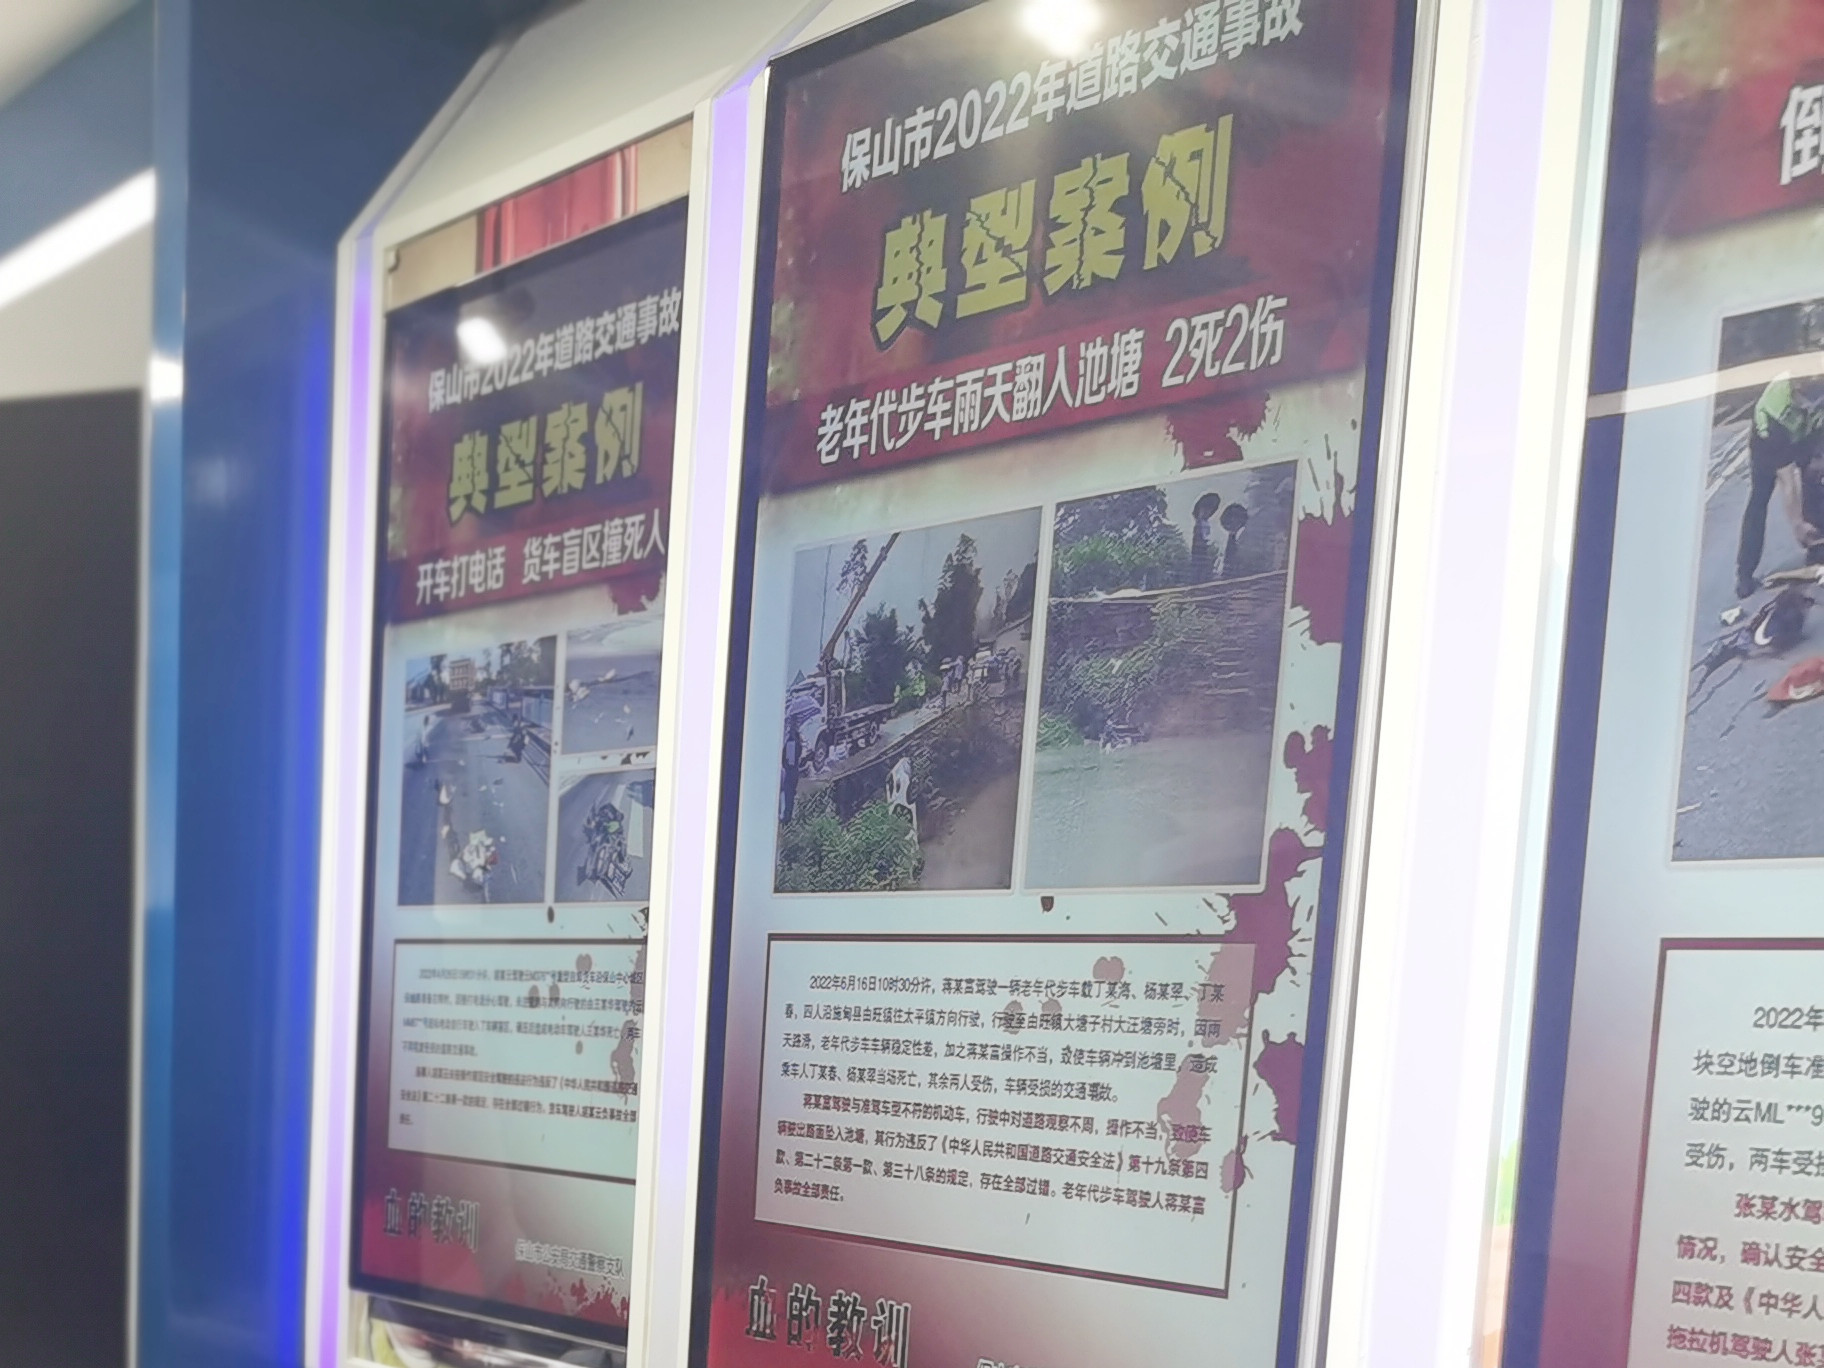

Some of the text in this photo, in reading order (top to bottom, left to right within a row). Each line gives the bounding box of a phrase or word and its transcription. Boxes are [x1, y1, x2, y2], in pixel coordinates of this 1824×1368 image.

[840, 0, 1303, 192] 保山市2022年道路交通事故
[874, 114, 1233, 344] 典型案例
[1162, 295, 1288, 387] 2死2伤
[448, 382, 643, 526] 典型案例
[416, 508, 666, 606] 开车打电话 货车盲区撞死人
